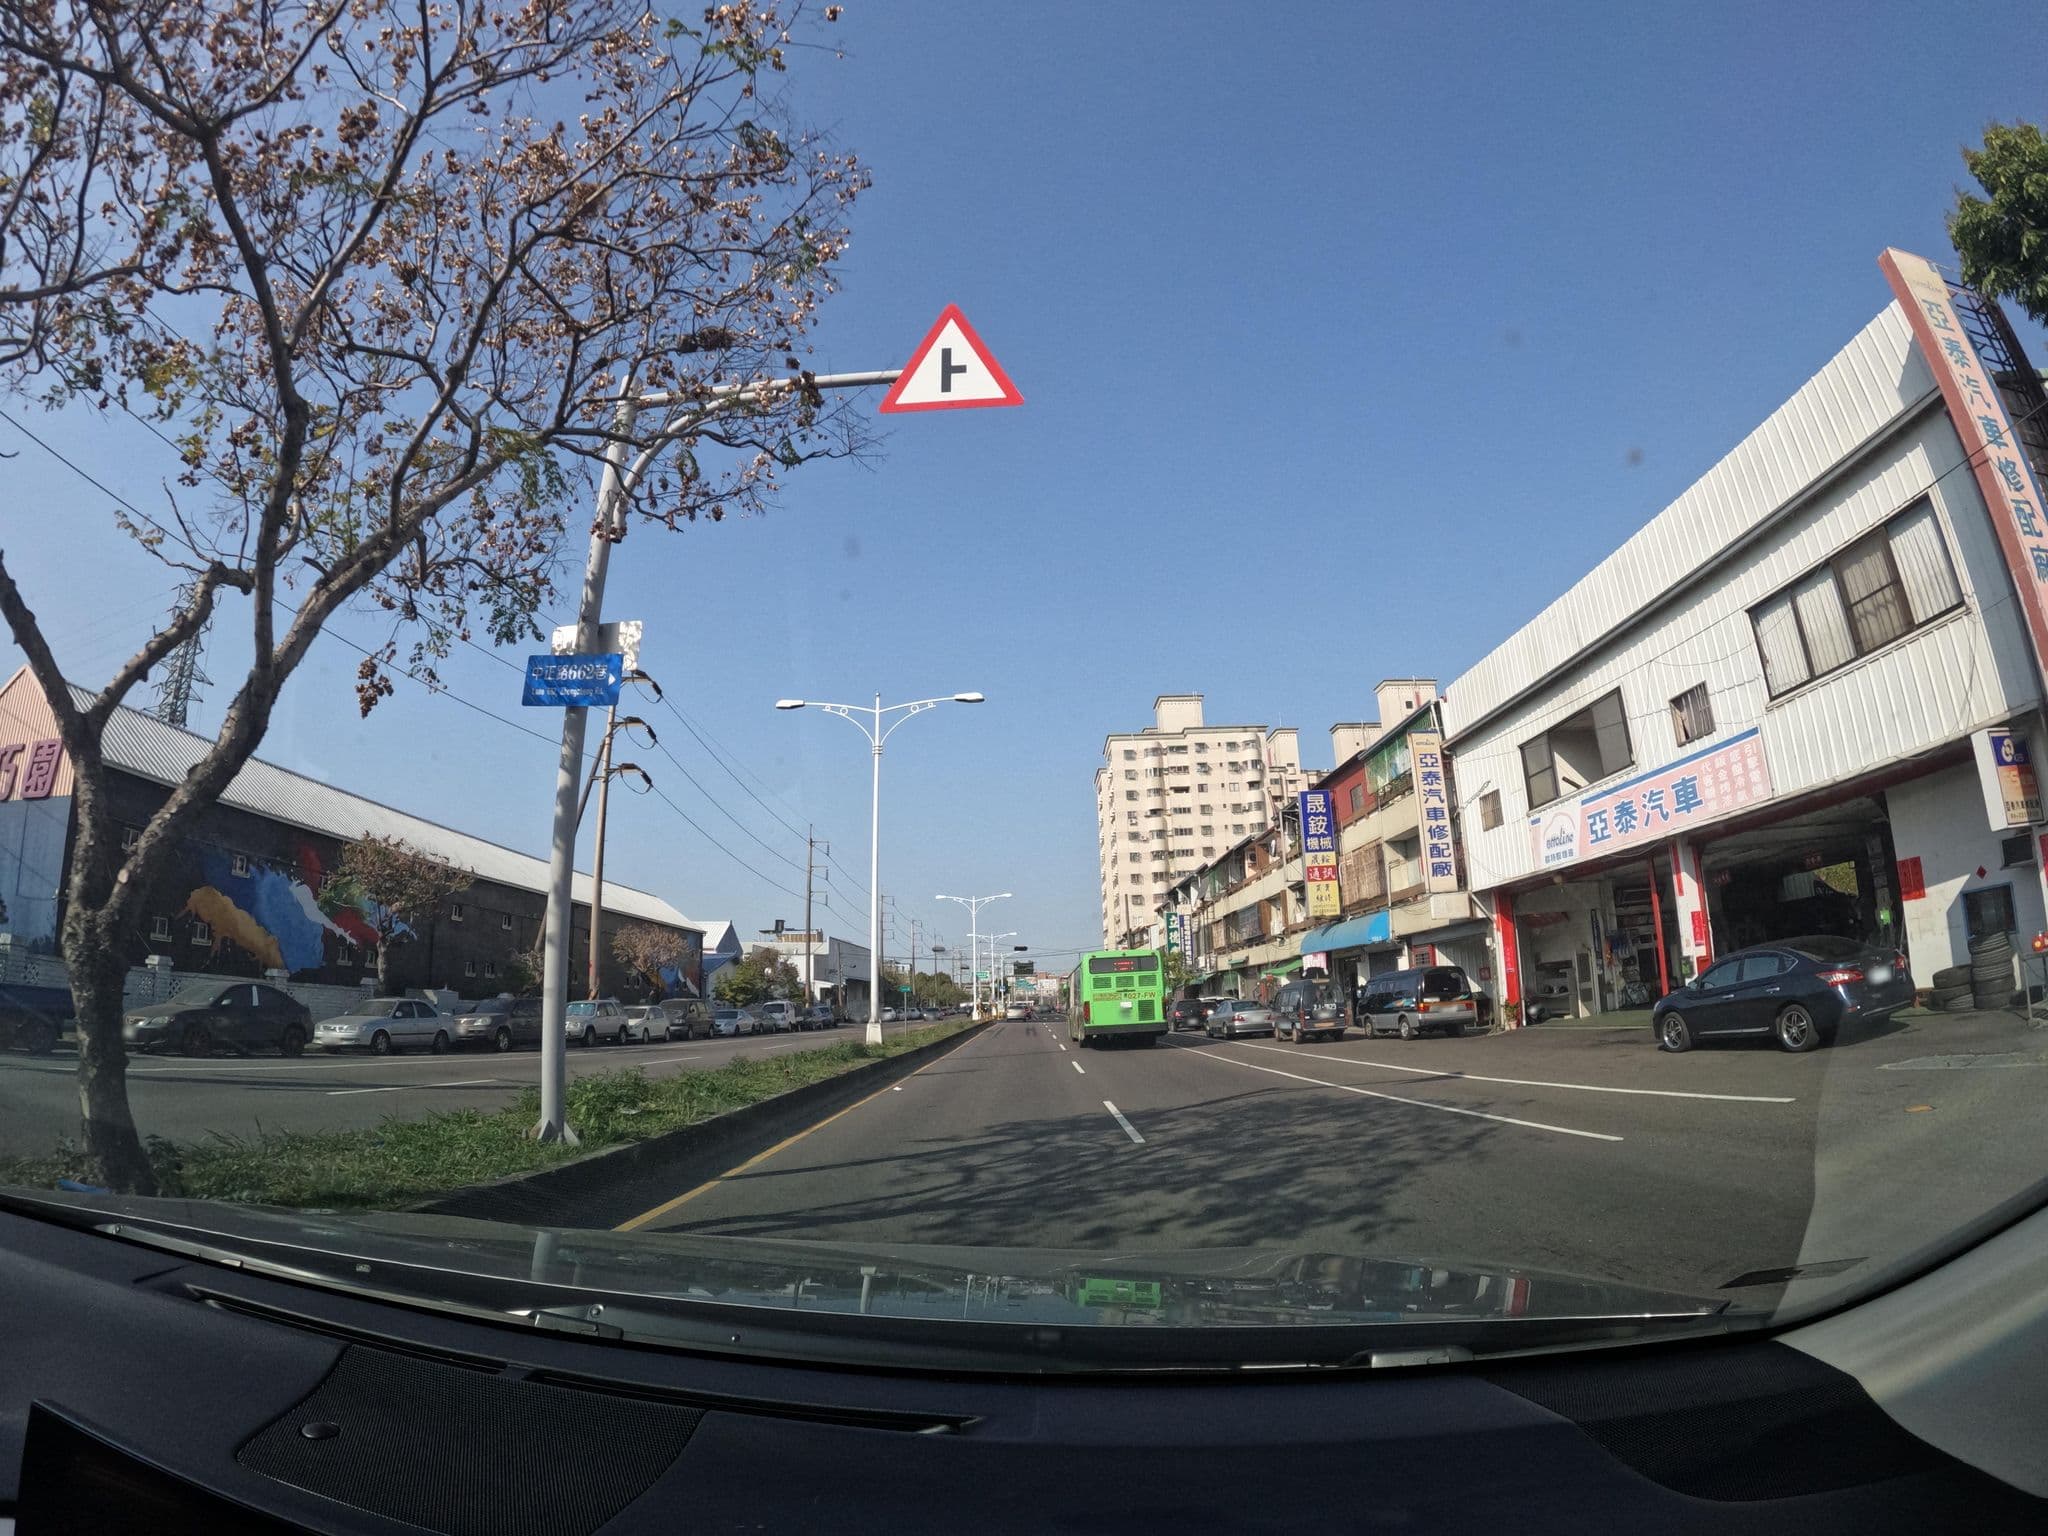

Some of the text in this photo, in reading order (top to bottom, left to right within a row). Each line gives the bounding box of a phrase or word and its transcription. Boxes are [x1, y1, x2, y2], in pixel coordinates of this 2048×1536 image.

[1418, 753, 1454, 877] 亞泰汽車修配廠
[1587, 775, 1704, 844] 亞泰汽車
